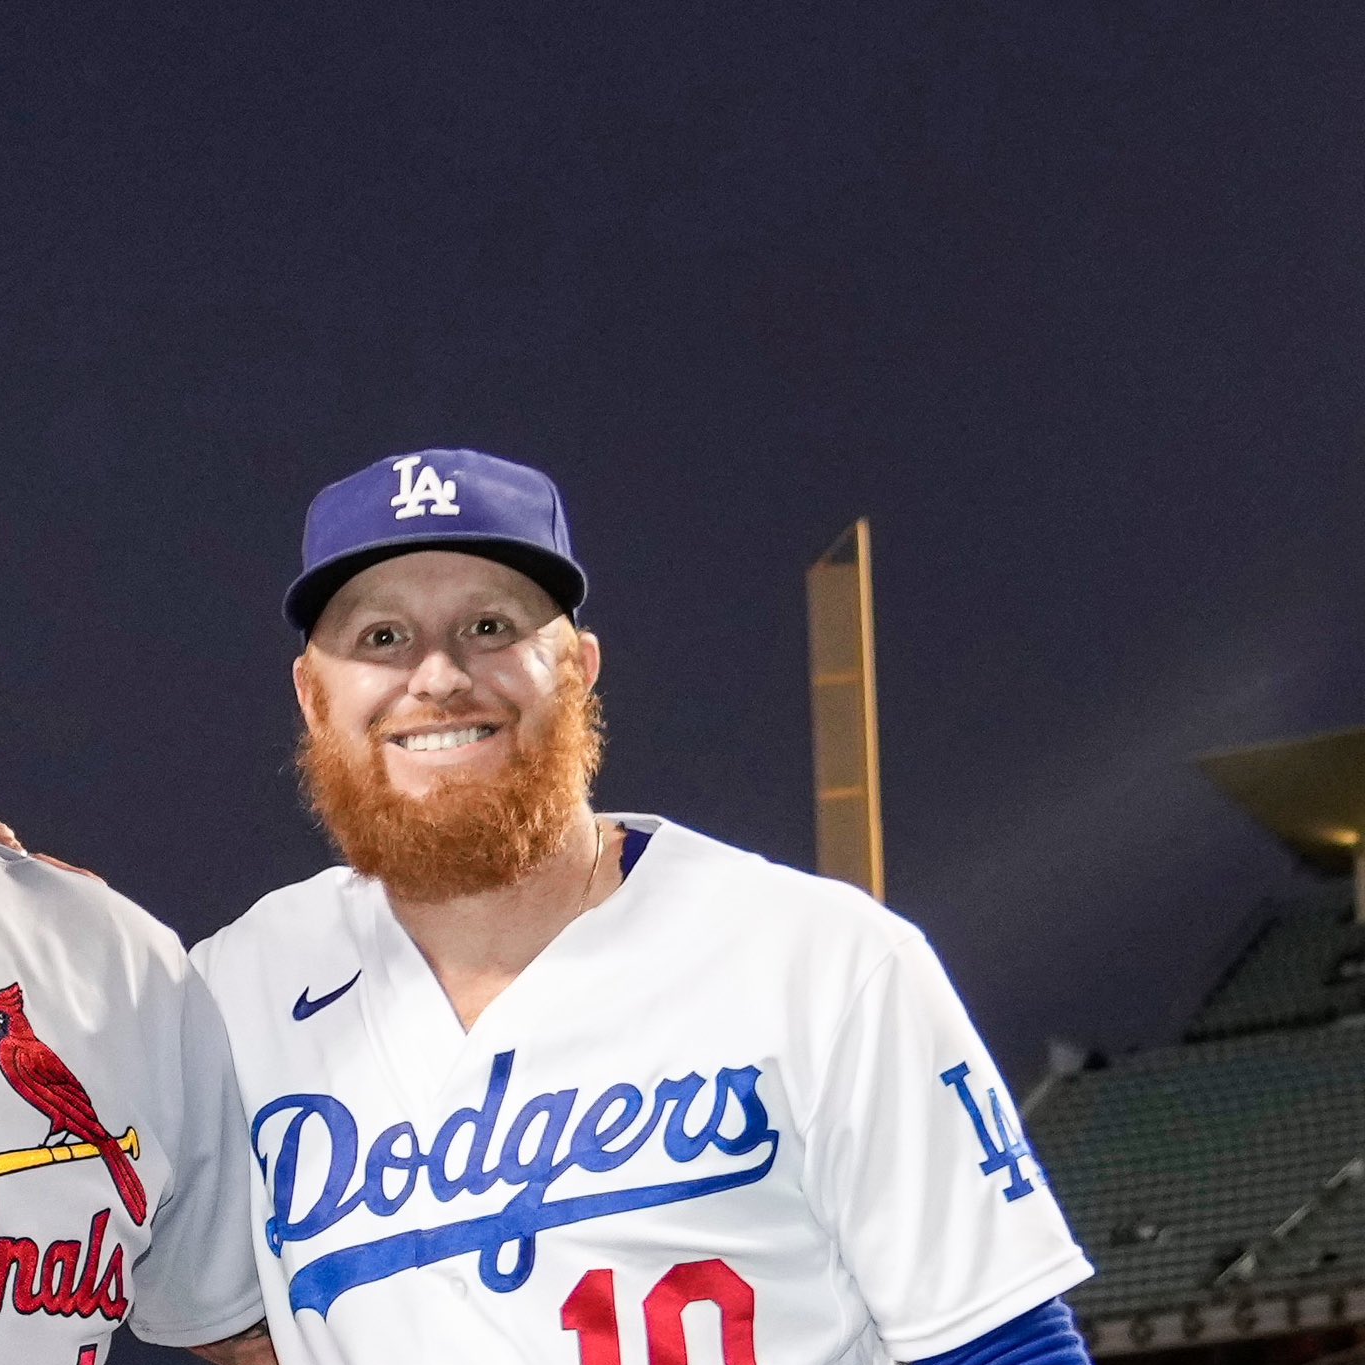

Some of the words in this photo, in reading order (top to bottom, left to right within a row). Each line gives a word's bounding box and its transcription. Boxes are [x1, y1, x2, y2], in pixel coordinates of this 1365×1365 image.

[390, 455, 461, 520] LA
[250, 1049, 780, 1322] Dodgers
[939, 1060, 1048, 1203] LA
